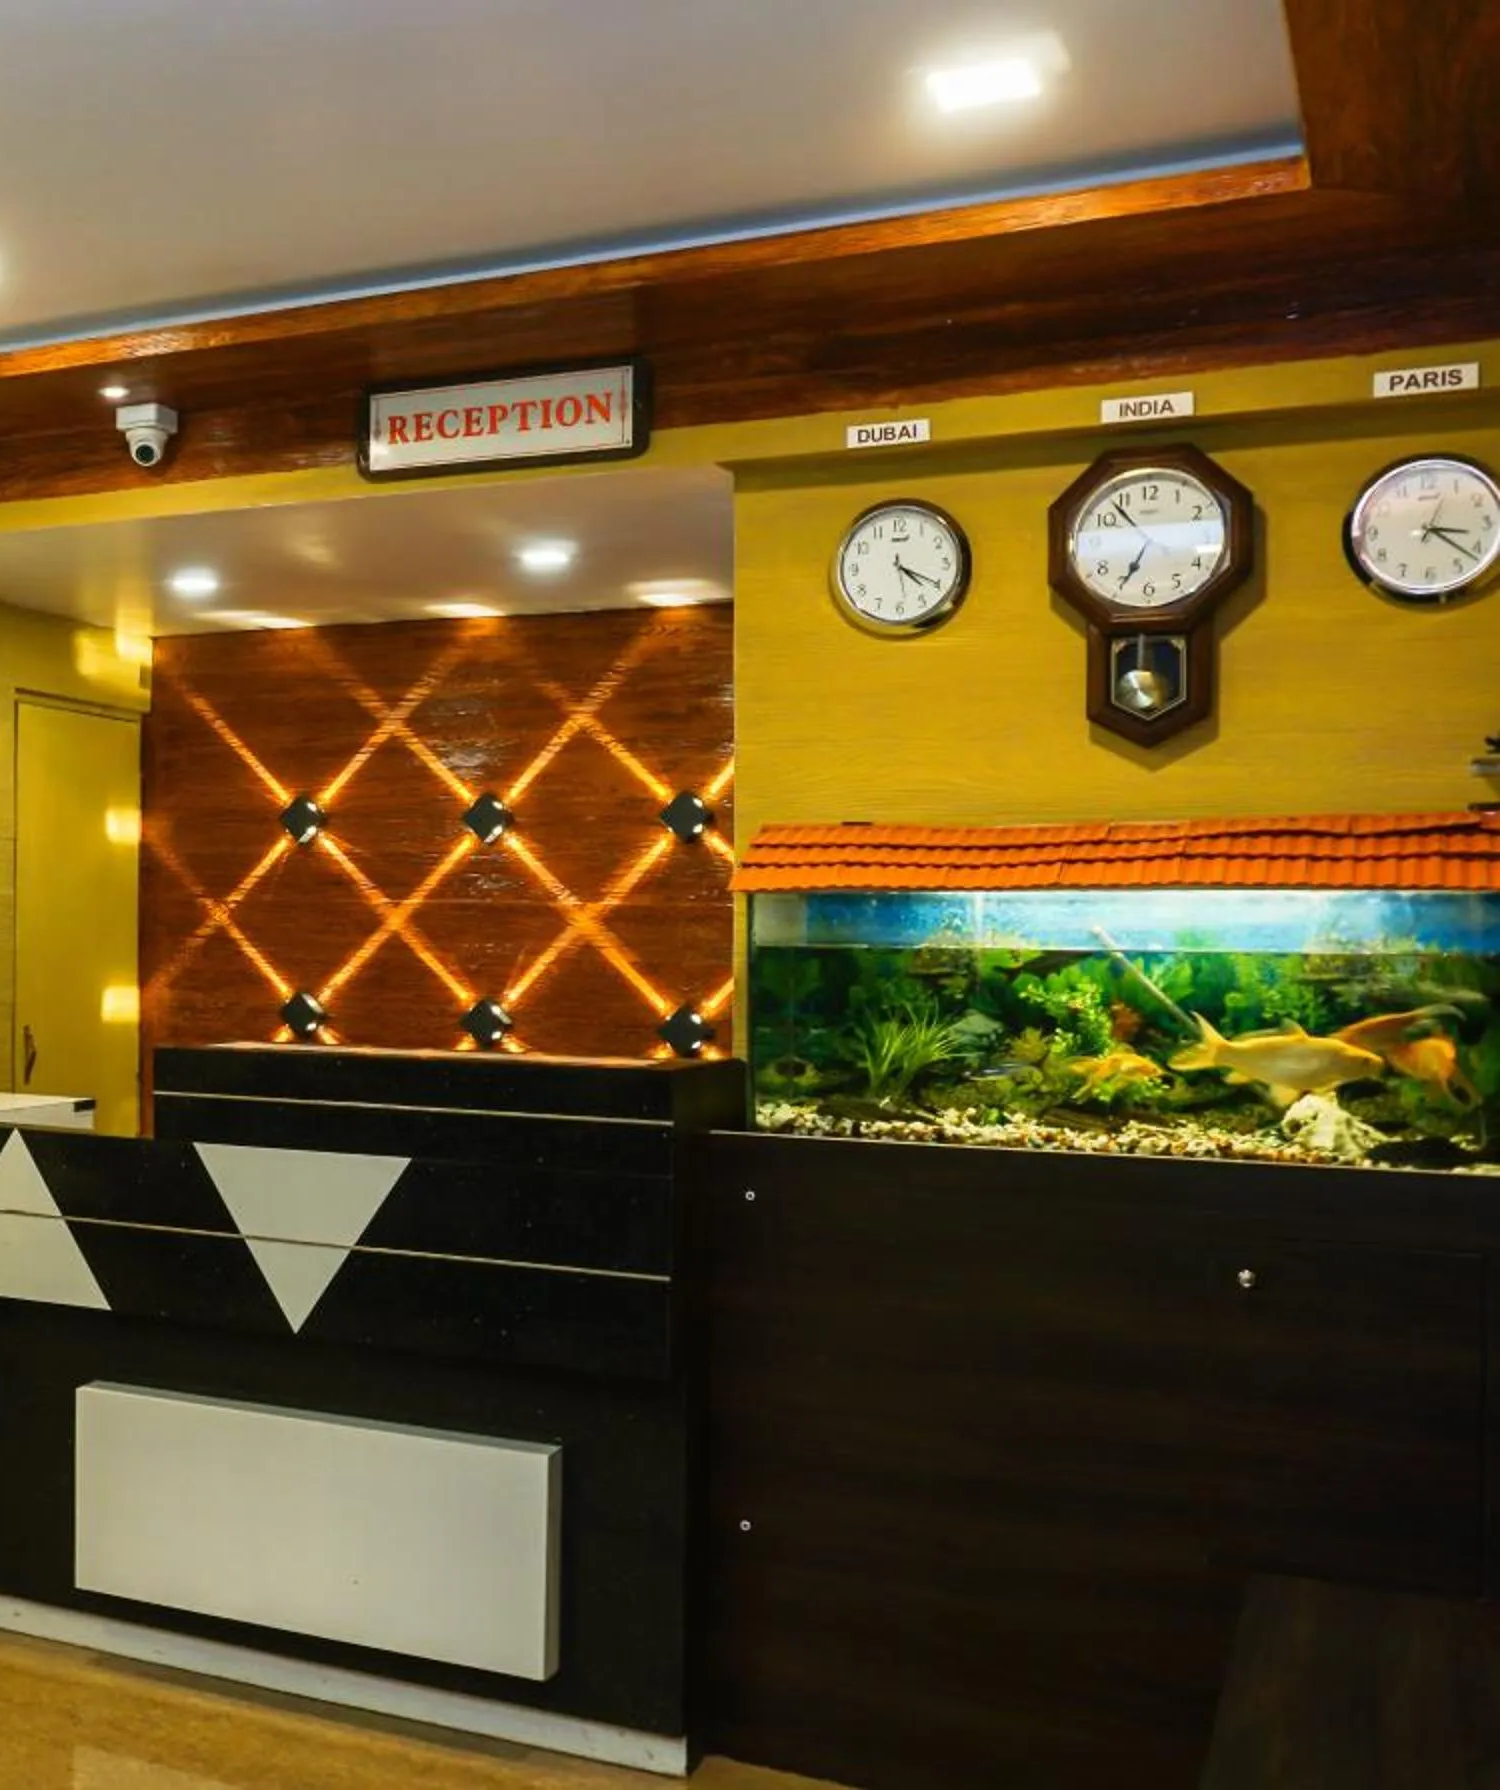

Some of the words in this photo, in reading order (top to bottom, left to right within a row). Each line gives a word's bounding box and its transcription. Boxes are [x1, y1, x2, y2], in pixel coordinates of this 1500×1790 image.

[1389, 369, 1463, 392] PARIS
[1119, 400, 1175, 417] INDIA
[387, 391, 613, 445] RECEPTION
[857, 424, 917, 443] DUBAI
[1119, 493, 1130, 507] 11
[1143, 485, 1159, 501] 12
[1097, 512, 1116, 528] 10
[1192, 505, 1203, 521] 2
[873, 525, 883, 539] 11
[893, 519, 907, 533] 12
[856, 540, 869, 555] 10
[934, 536, 943, 550] 2
[851, 563, 859, 577] 9
[1097, 560, 1108, 576] 8
[1191, 556, 1201, 571] 4
[1397, 562, 1407, 577] 7
[1172, 573, 1182, 589] 5
[858, 584, 867, 597] 8
[1143, 581, 1155, 597] 6
[874, 597, 883, 611] 7
[896, 601, 905, 614] 6
